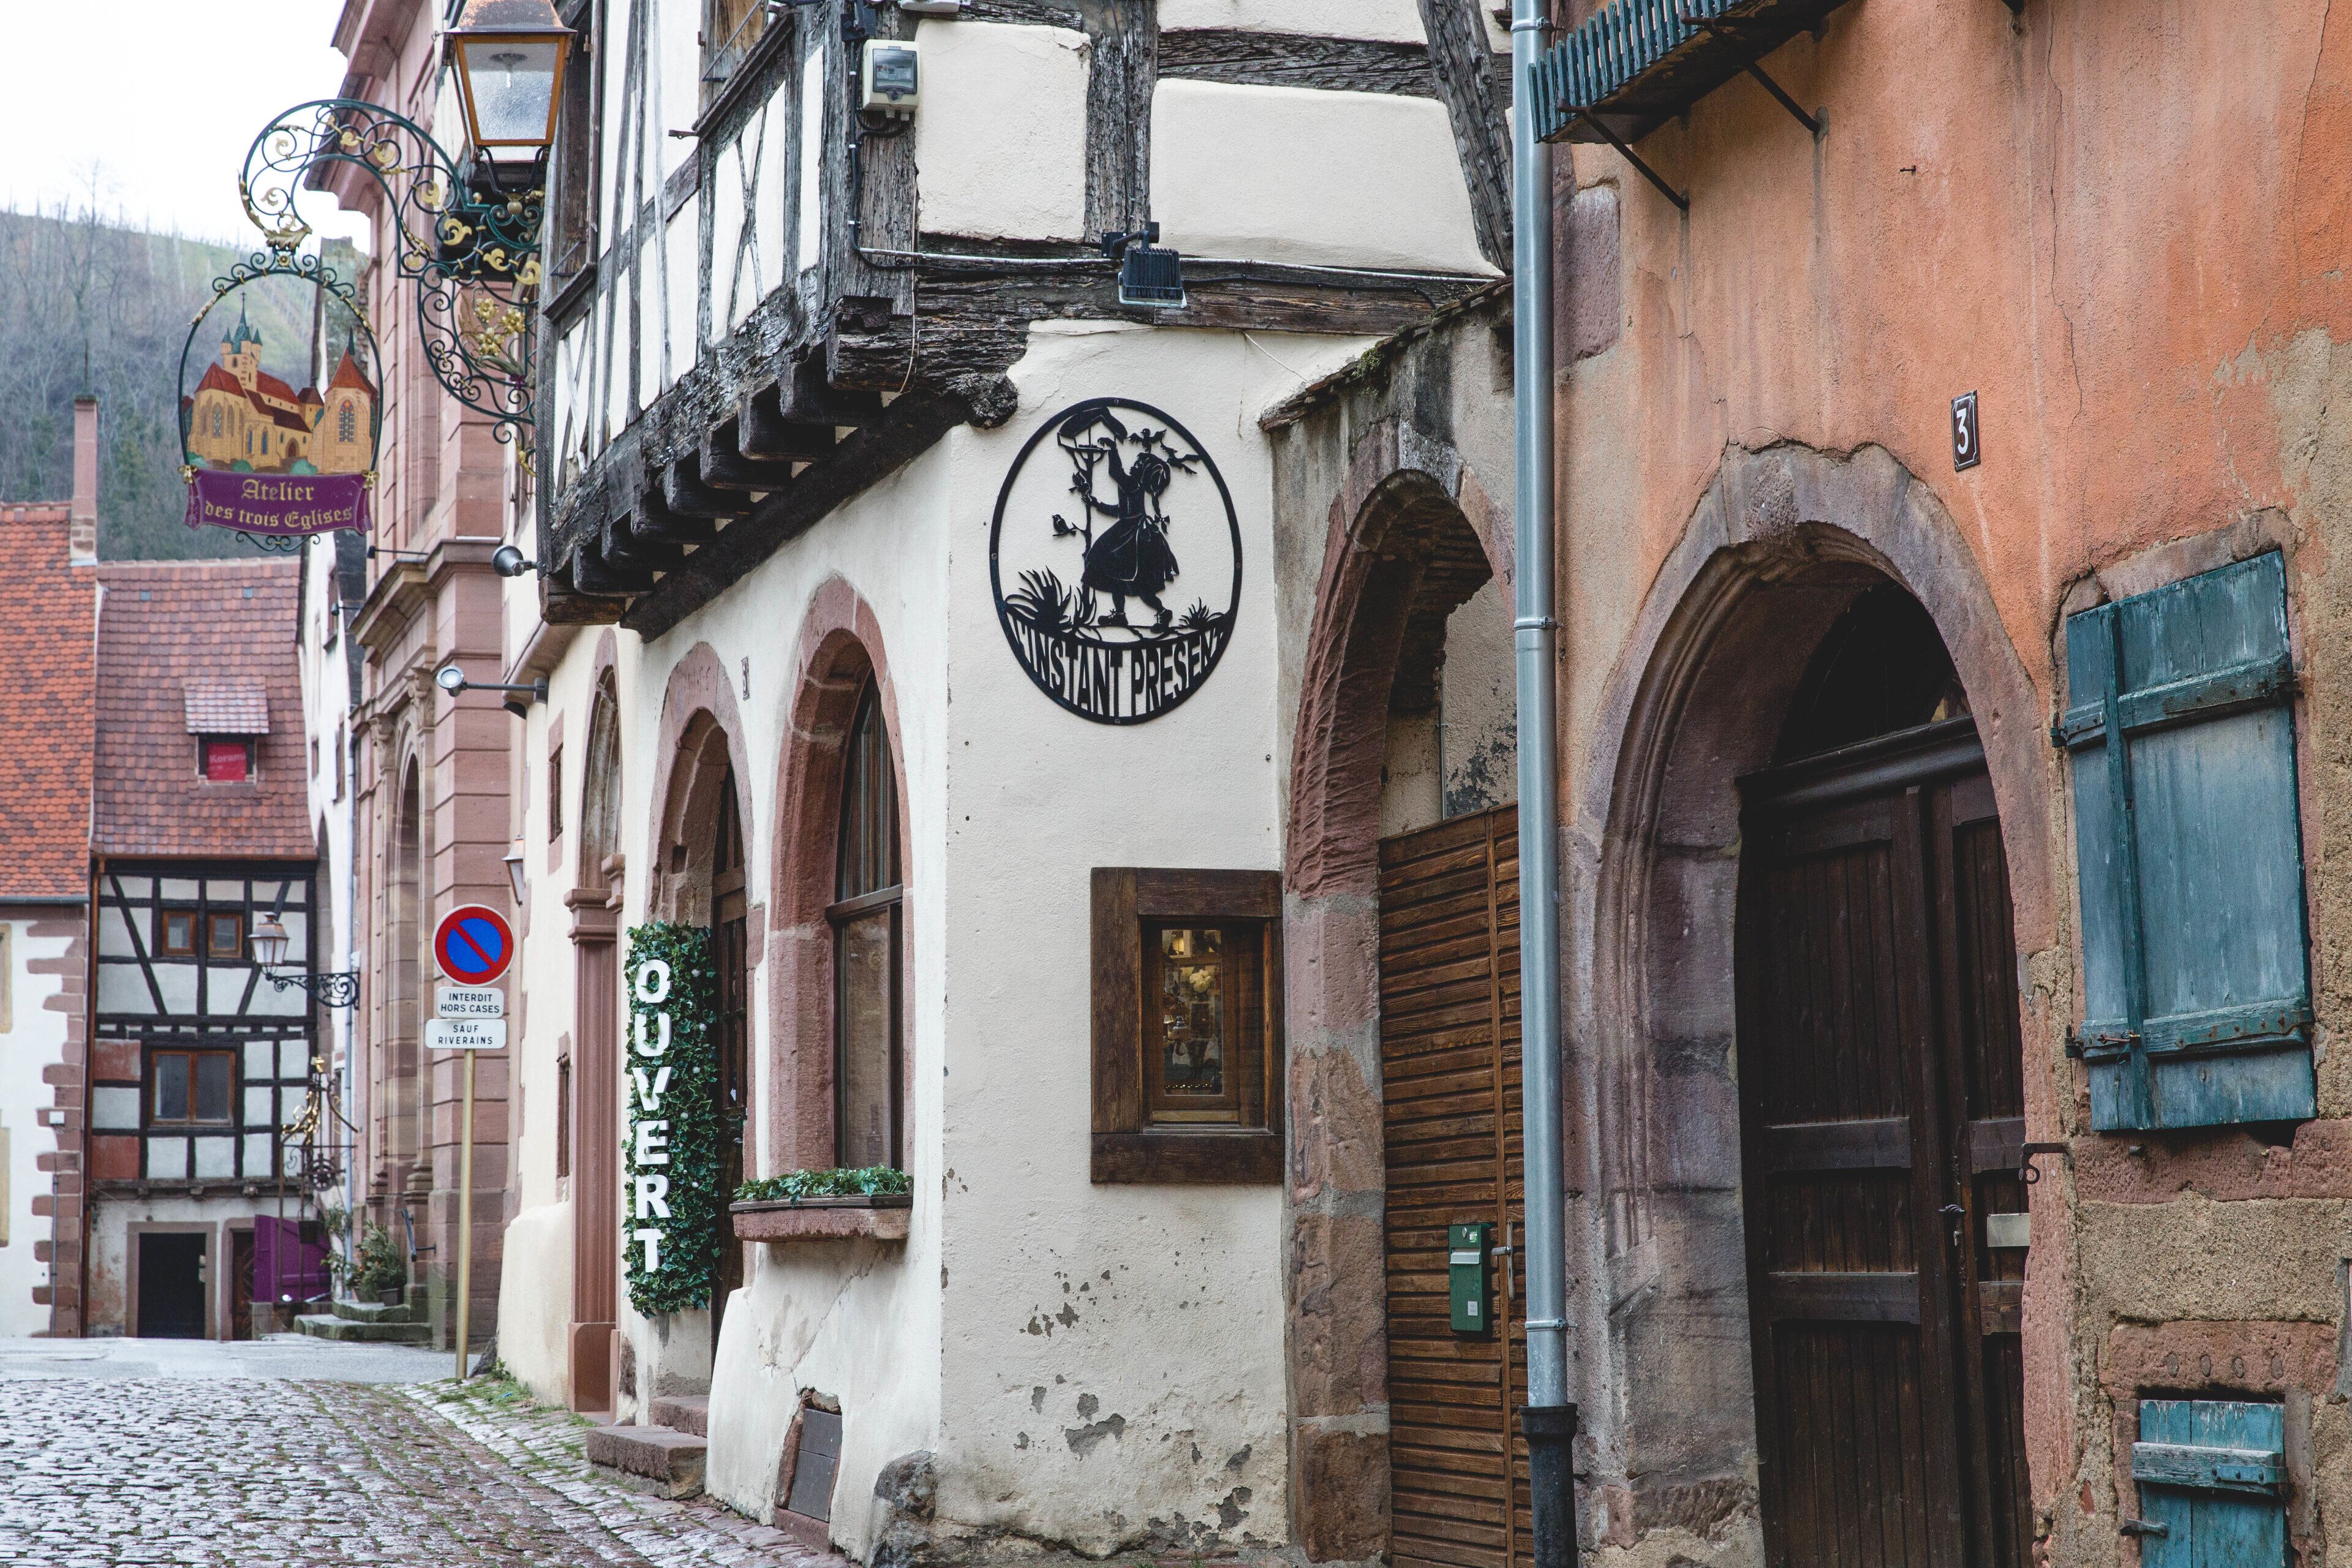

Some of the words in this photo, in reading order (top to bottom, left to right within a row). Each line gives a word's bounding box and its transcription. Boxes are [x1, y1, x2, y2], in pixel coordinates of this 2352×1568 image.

[1956, 407, 1969, 454] 3
[241, 478, 315, 501] Atelier
[204, 500, 235, 519] des
[239, 510, 279, 527] trois
[284, 507, 352, 530] Eglises
[1131, 625, 1224, 717] PRESENT
[449, 993, 492, 1001] INTERDIT
[633, 959, 673, 1273] OUVERT
